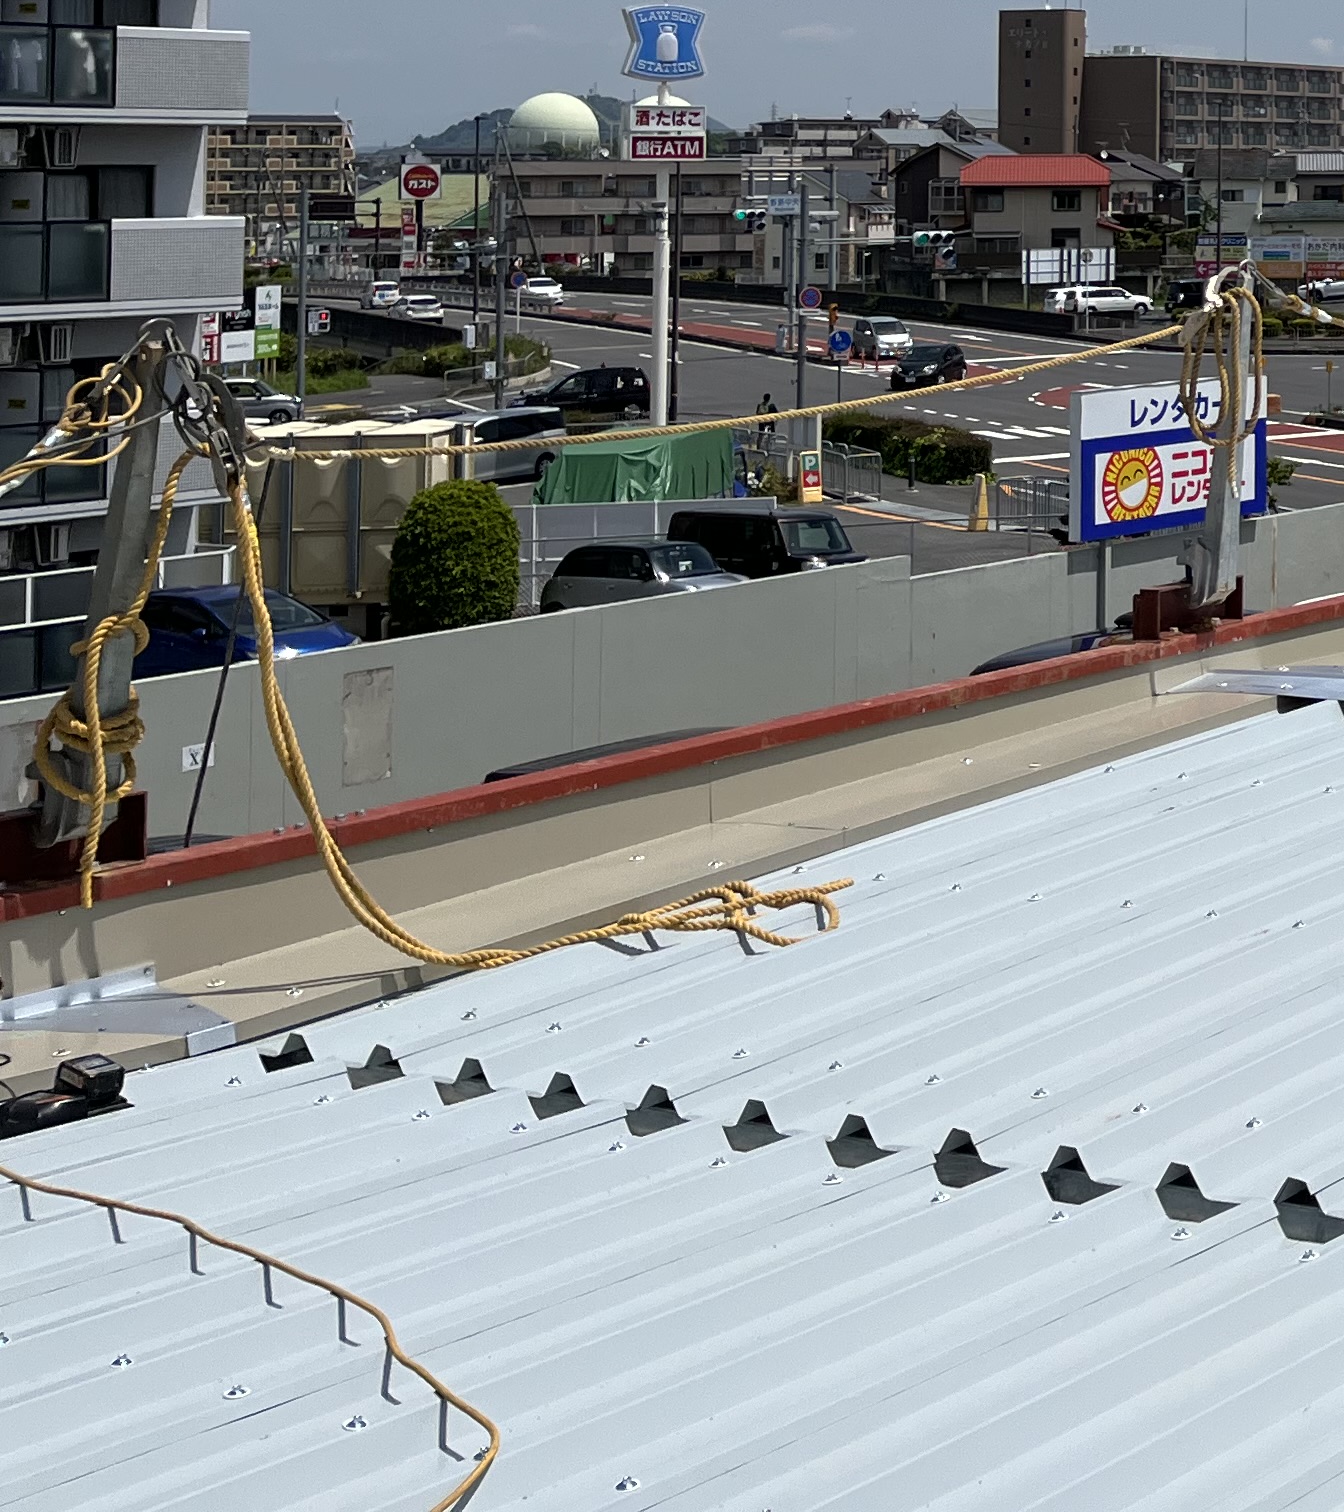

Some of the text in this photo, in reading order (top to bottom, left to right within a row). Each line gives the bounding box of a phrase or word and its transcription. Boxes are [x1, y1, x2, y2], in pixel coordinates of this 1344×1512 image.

[638, 11, 698, 25] LAWSON
[637, 59, 698, 74] STATION
[635, 110, 701, 127] 酒・たばこ
[636, 141, 700, 156] 銀行ATM
[408, 180, 436, 189] ガスト
[805, 455, 816, 471] P
